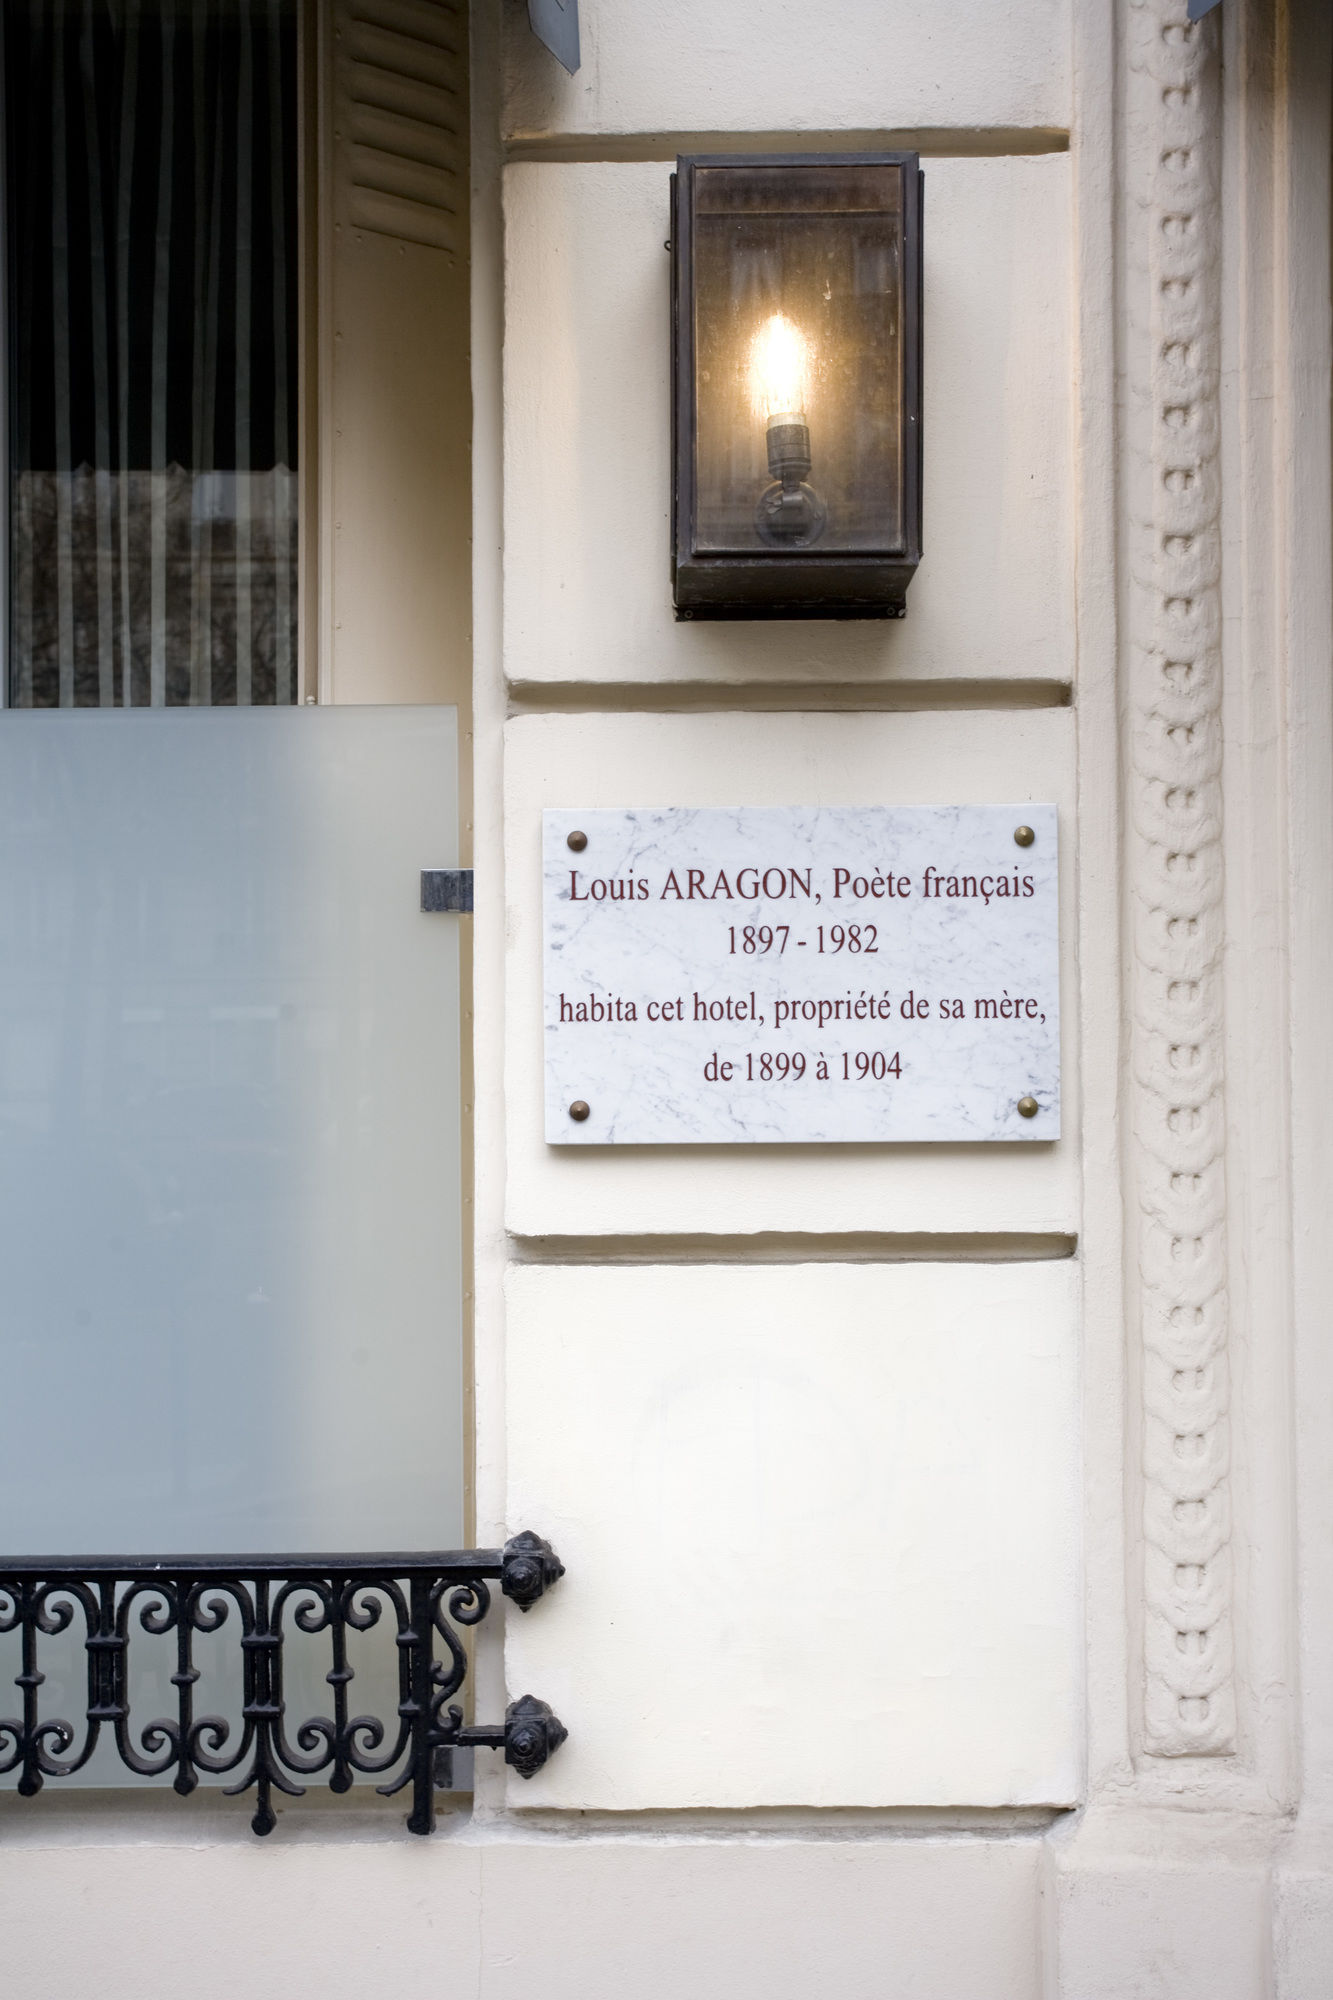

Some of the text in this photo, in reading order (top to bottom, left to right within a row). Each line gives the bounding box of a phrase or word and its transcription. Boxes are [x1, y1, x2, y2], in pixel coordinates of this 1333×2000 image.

[568, 864, 1035, 906] Louis ARAGON, Poète français
[728, 924, 792, 956] 1897
[817, 924, 879, 955] 1982
[559, 988, 1046, 1029] habita cet hotel, propriété de sa mère,
[703, 1050, 903, 1082] de 1899 à 1904
